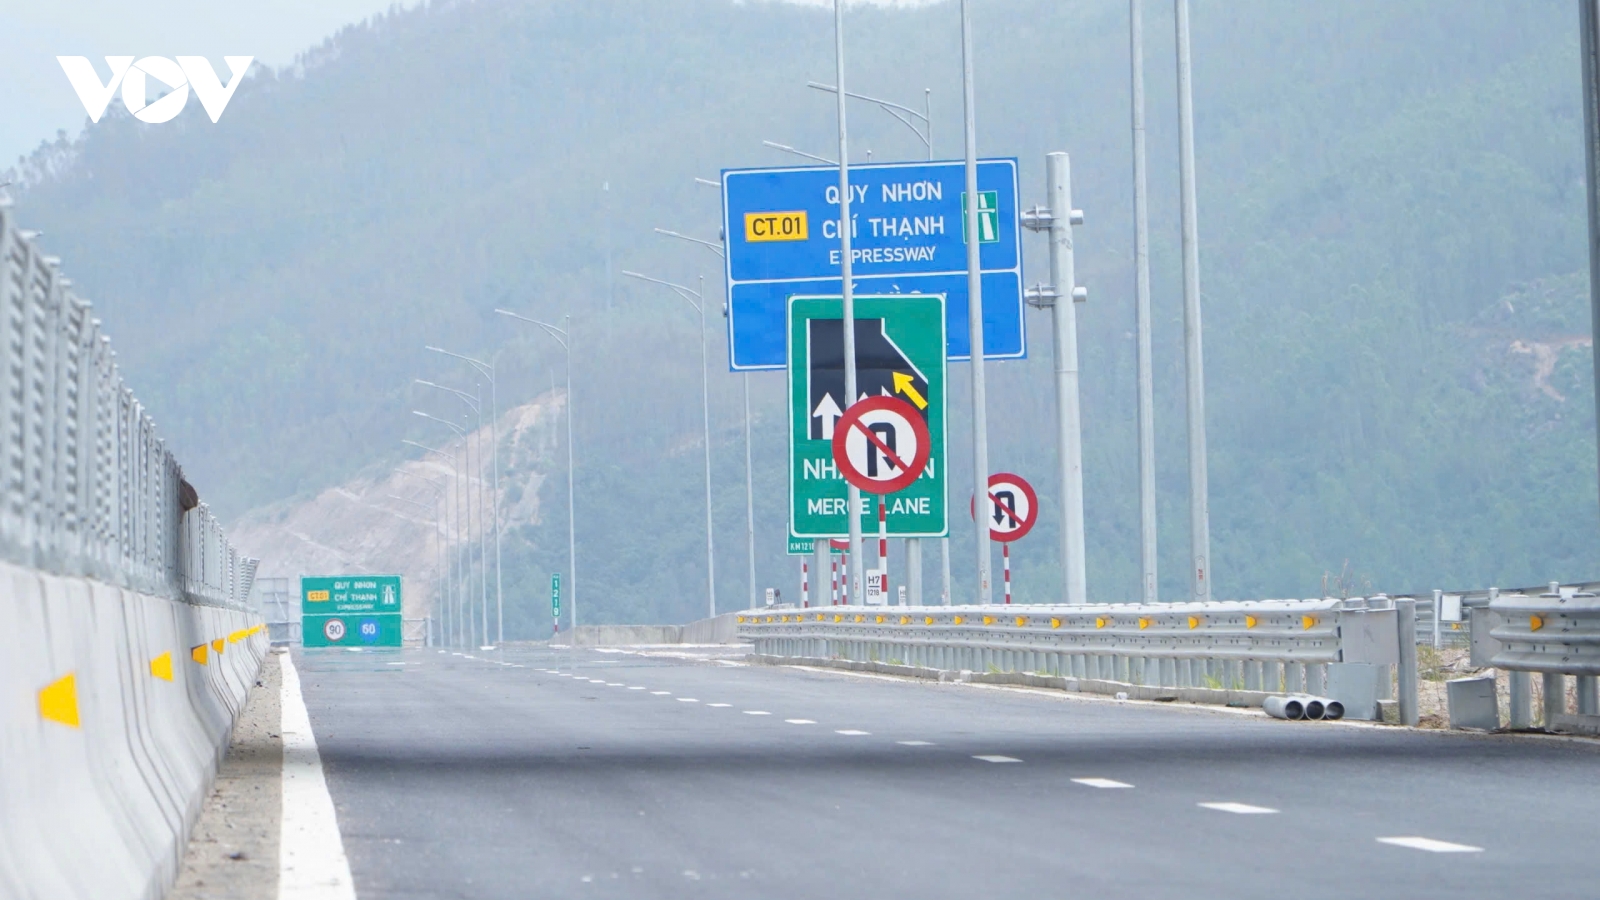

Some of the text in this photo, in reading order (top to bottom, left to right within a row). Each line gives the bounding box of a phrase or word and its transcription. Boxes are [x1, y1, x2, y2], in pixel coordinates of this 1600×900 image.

[882, 180, 942, 203] NHƠN
[752, 216, 801, 236] CT.01
[868, 215, 945, 241] THẠNH
[829, 245, 936, 265] EPRESSWAY
[807, 497, 871, 515] MERE
[868, 576, 880, 584] H7
[328, 623, 376, 635] 90 60
